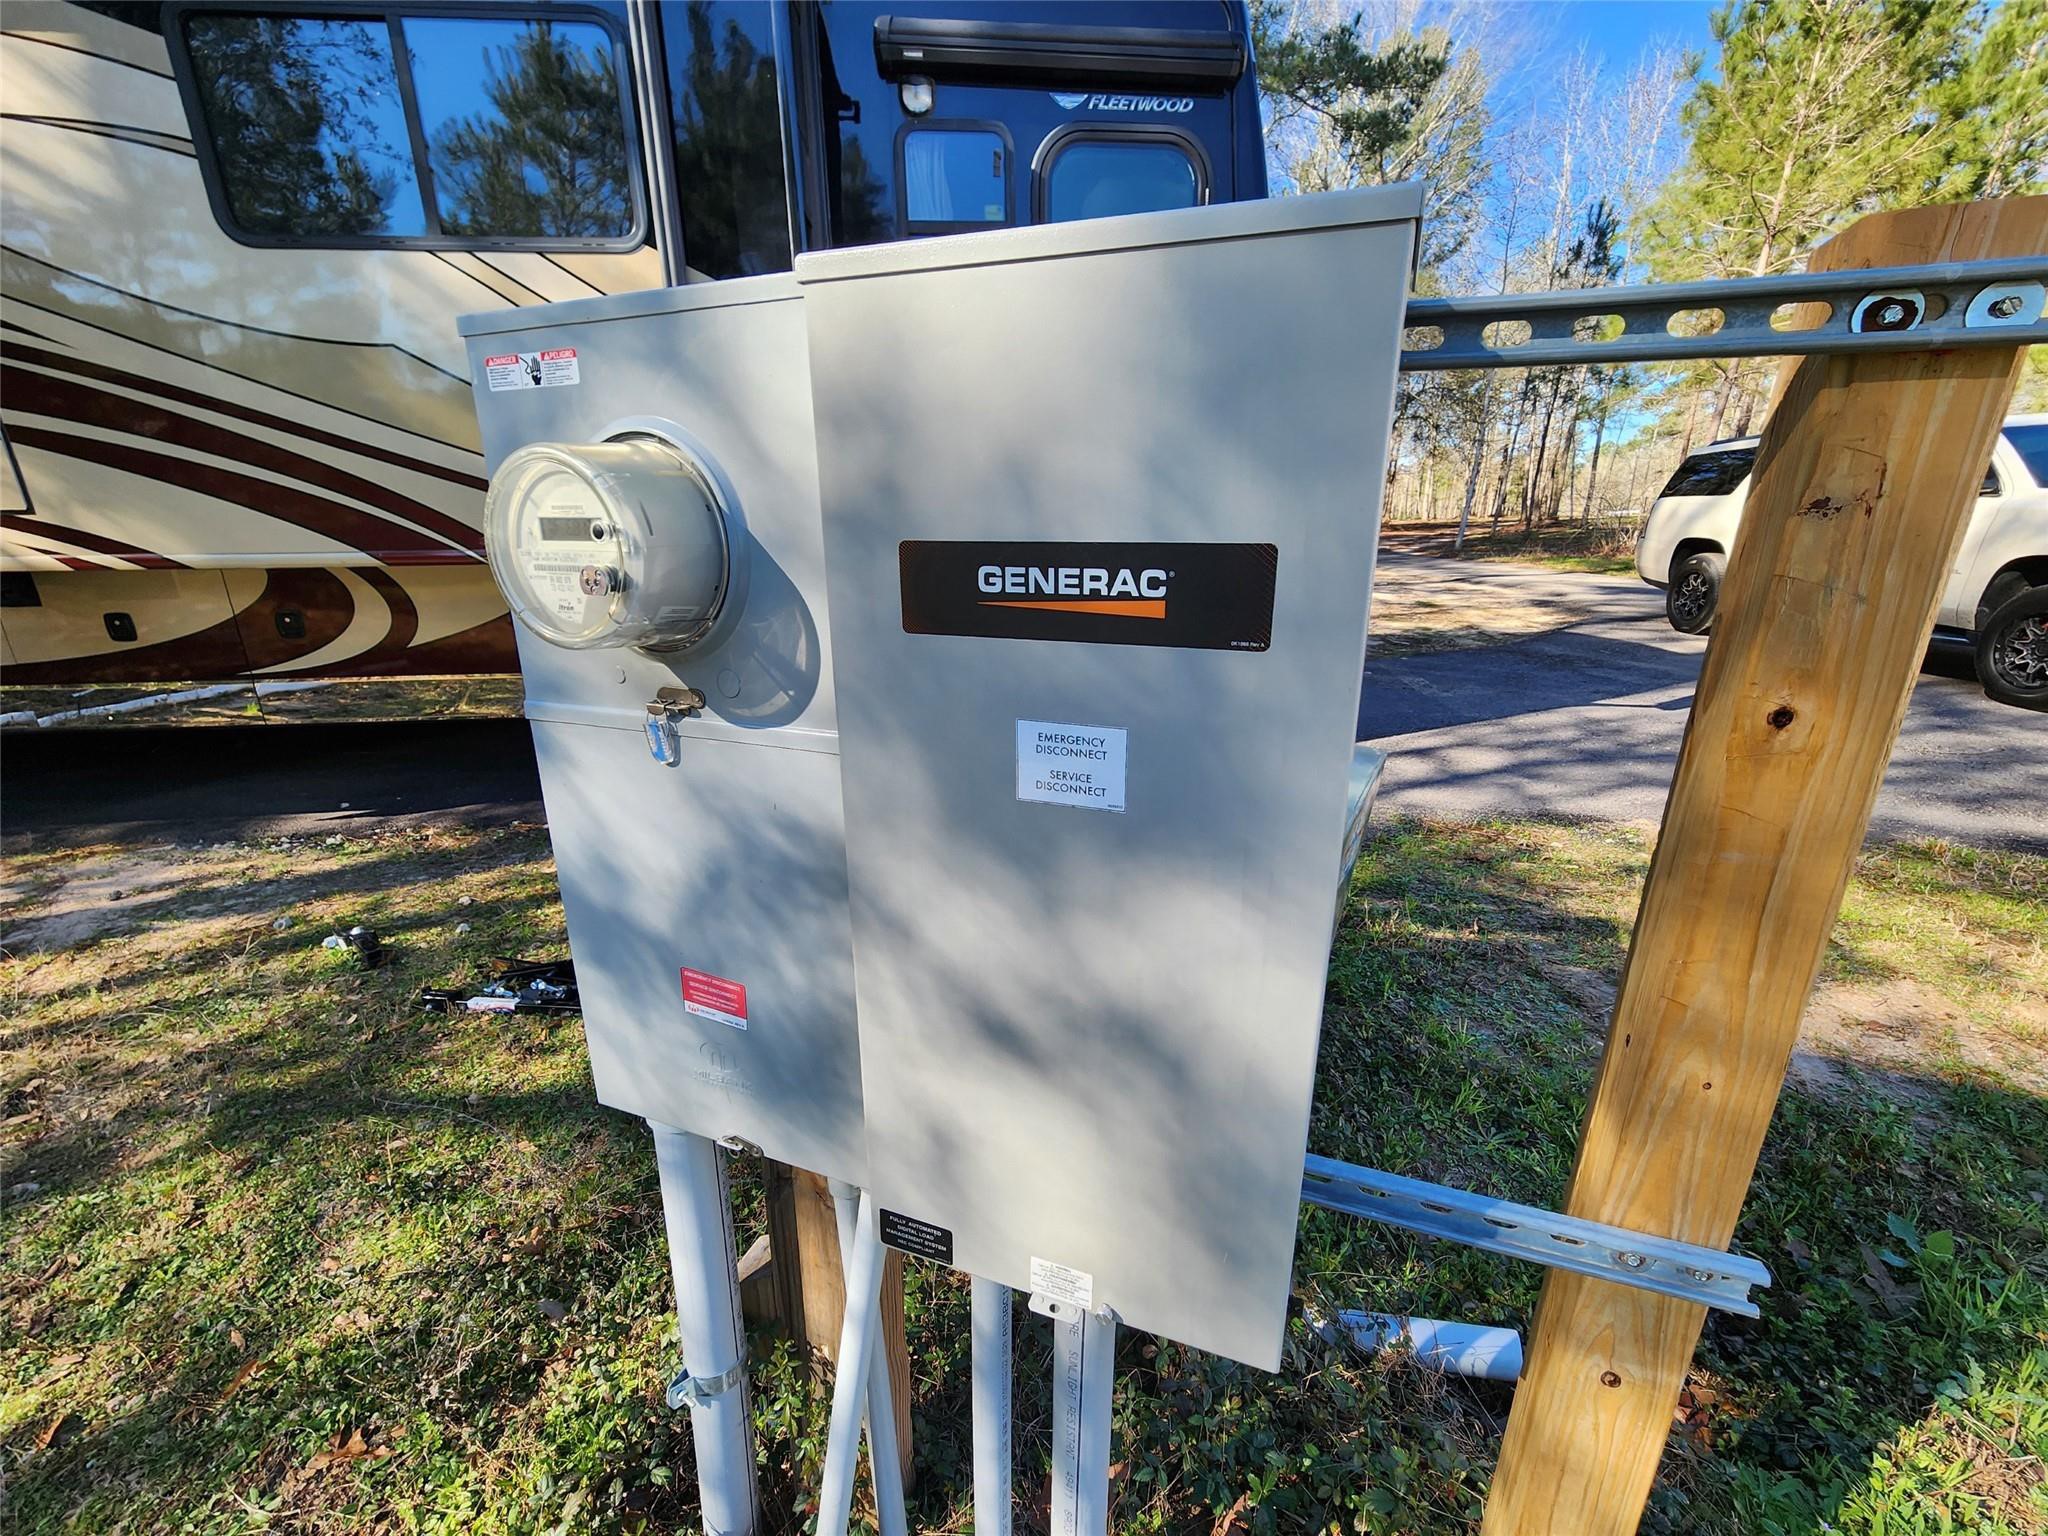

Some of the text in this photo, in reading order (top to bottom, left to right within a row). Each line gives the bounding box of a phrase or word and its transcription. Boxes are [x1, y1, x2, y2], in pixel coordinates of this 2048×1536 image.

[1088, 94, 1194, 113] FLEETWOOD
[494, 356, 516, 364] DANGER
[549, 349, 574, 360] PELIGRO
[977, 565, 1167, 598] GENERAC
[1038, 732, 1106, 748] EMERGENCY
[1036, 744, 1108, 761] DISCONNECT
[1050, 769, 1092, 784] SERVICE
[1036, 780, 1107, 797] DISCONNECT
[889, 1215, 942, 1237] FULLY AUTOMATED
[897, 1225, 935, 1241] DIGITAL LOAD
[885, 1228, 947, 1251] MANAGEMENT SYSTEM
[907, 1239, 935, 1254] COMPLIANT
[1067, 1350, 1079, 1400] SUNLIGHT
[1065, 1404, 1077, 1460] RESISTANT
